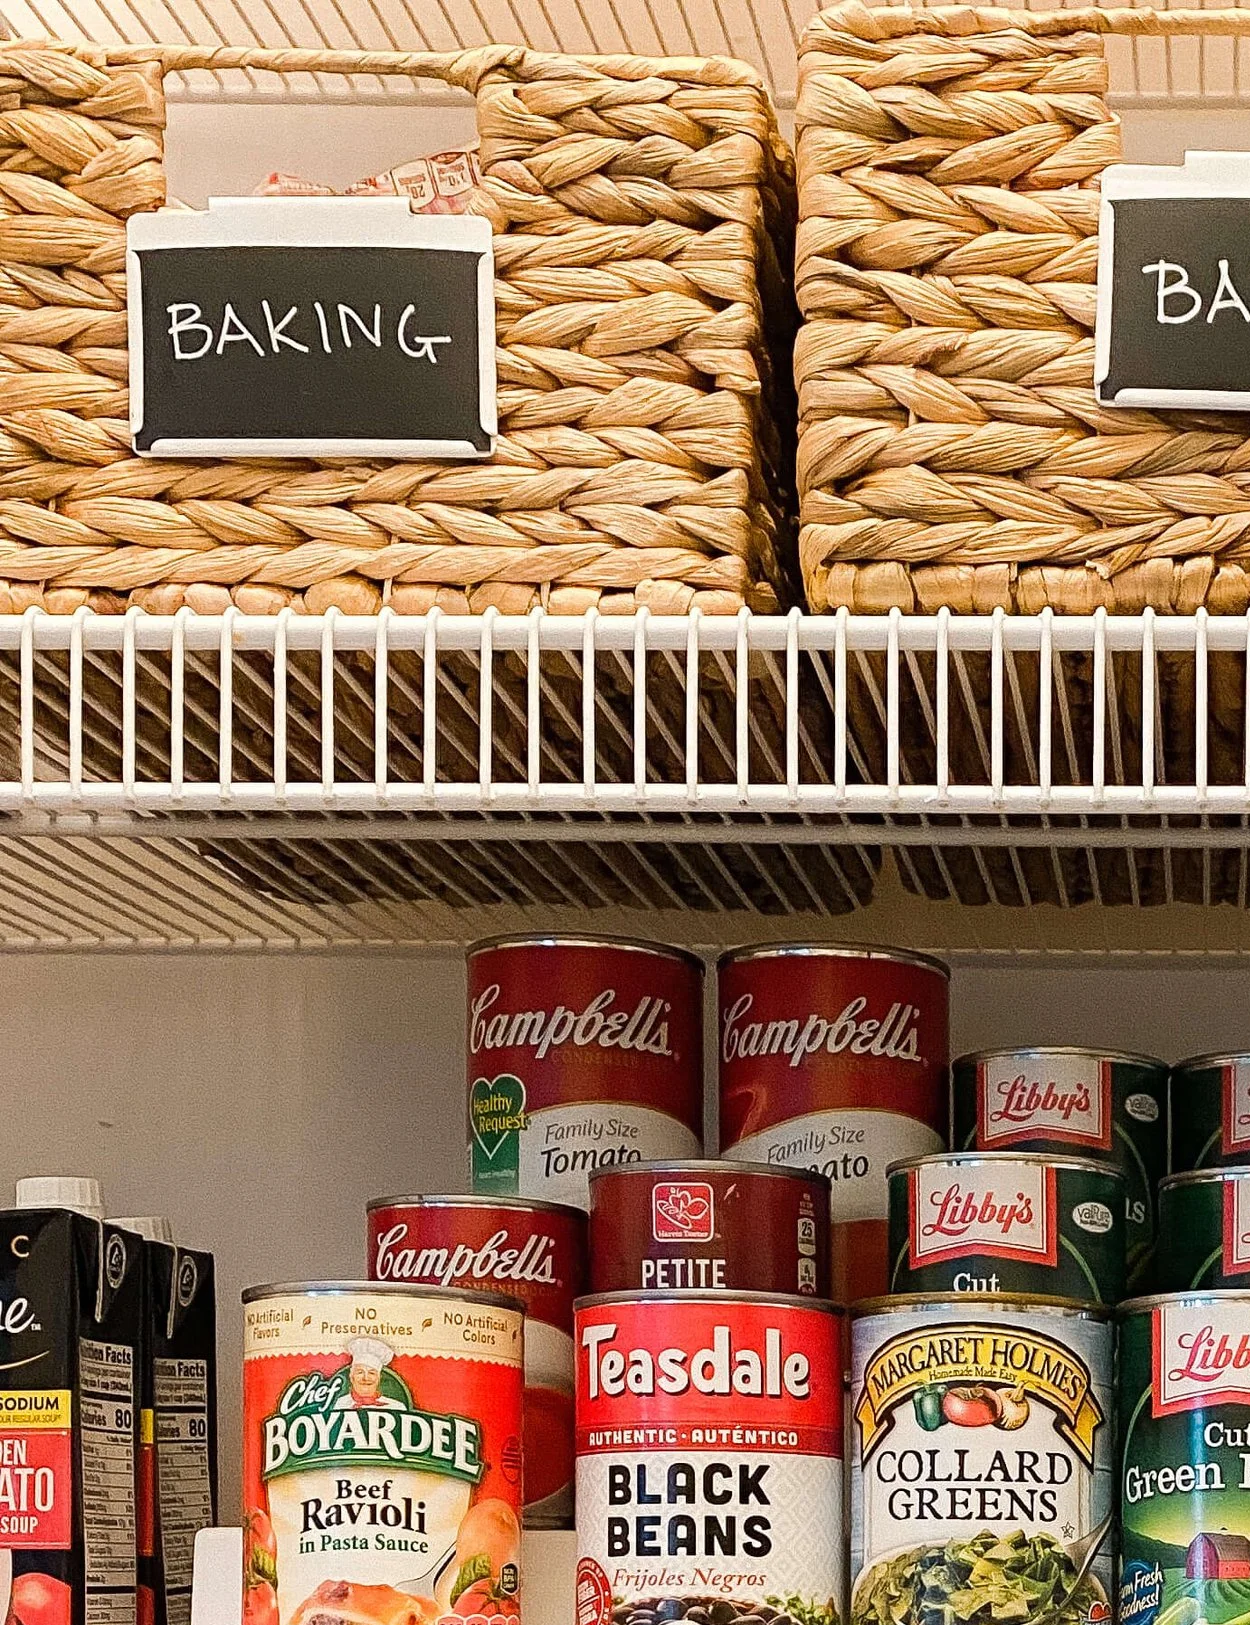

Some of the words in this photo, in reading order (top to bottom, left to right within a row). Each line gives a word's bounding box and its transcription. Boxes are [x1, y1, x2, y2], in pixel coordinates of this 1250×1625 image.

[166, 301, 452, 364] BAKING
[471, 984, 672, 1058] Campbell's
[723, 993, 923, 1067] Campbell's
[474, 1093, 512, 1115] Healthy
[990, 1075, 1091, 1122] Libby's
[479, 1113, 527, 1134] Request
[545, 1119, 603, 1144] Family
[606, 1119, 639, 1138] Size
[768, 1130, 824, 1164] Family
[826, 1126, 865, 1146] Size
[922, 1184, 1033, 1236] Libby's
[376, 1224, 556, 1286] Campbell's
[642, 1259, 727, 1288] PETITE
[953, 1273, 1000, 1292] Cut
[256, 1309, 294, 1323] Artificial
[355, 1308, 377, 1320] NO
[444, 1313, 463, 1325] NO
[466, 1315, 509, 1331] Artificial
[253, 1327, 280, 1339] Flavors
[321, 1322, 413, 1336] Preservatives
[463, 1330, 496, 1345] Colors
[105, 1346, 131, 1364] Facts
[582, 1324, 810, 1400] Teasdale
[872, 1337, 983, 1398] MARGARET
[990, 1339, 1083, 1399] HOLMES
[178, 1362, 205, 1377] Facts
[974, 1366, 997, 1378] Made
[999, 1368, 1016, 1382] Easy
[281, 1375, 340, 1414] Chef
[115, 1409, 131, 1428] 80
[189, 1418, 205, 1437] 80
[264, 1411, 480, 1473] BOYARDEE
[589, 1429, 677, 1446] AUTHENTIC
[692, 1425, 798, 1446] AUTÉNTICO
[877, 1450, 1072, 1485] COLLARD
[336, 1479, 393, 1499] Beef
[609, 1463, 770, 1505] BLACK
[1126, 1463, 1224, 1503] Green
[300, 1497, 427, 1535] Ravioli
[889, 1488, 1057, 1522] GREENS
[300, 1537, 315, 1554] in
[321, 1534, 369, 1551] Pasta
[375, 1534, 428, 1553] Sauce
[608, 1515, 772, 1557] BEANS
[613, 1569, 684, 1591] Frijoles
[691, 1568, 766, 1592] Negros
[1135, 1562, 1164, 1592] Fresh
